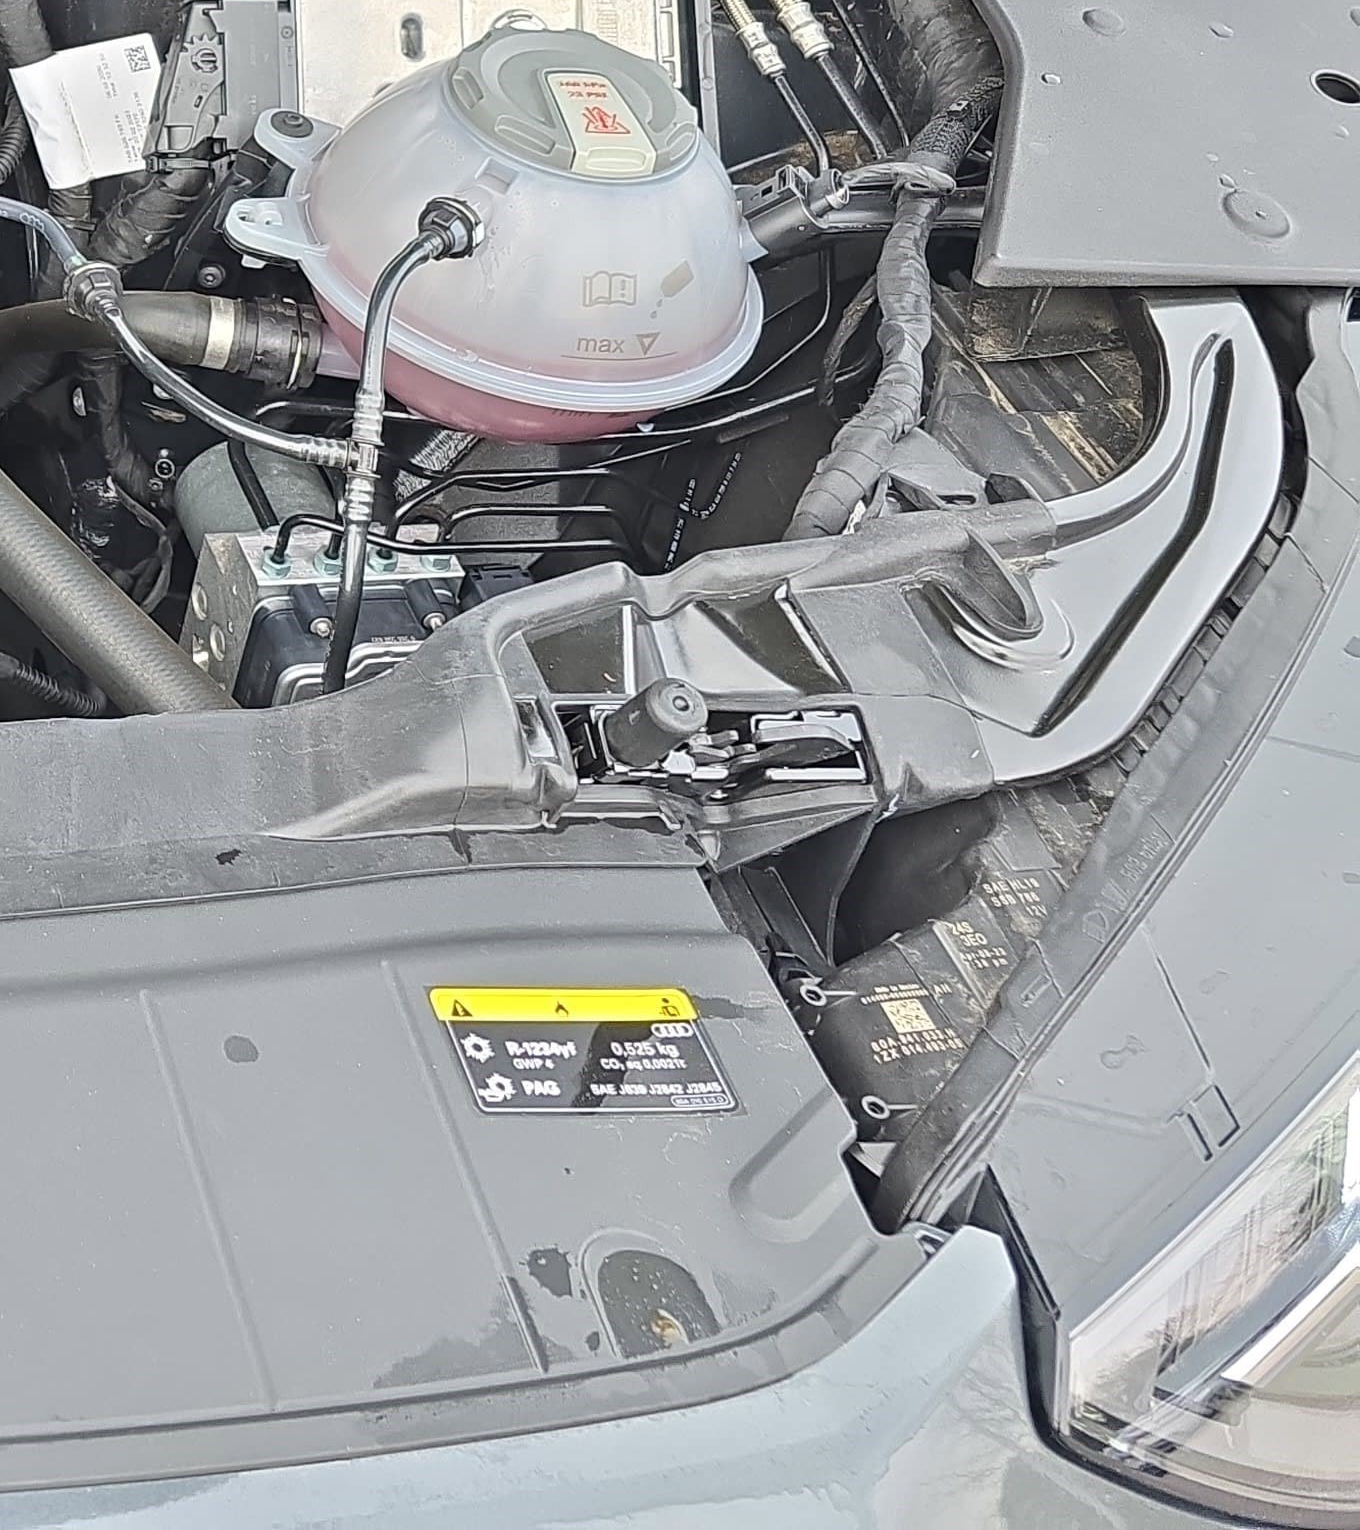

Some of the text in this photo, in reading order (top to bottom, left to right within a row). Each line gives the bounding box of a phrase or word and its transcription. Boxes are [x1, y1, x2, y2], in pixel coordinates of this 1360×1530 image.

[577, 337, 625, 353] max
[982, 881, 1009, 894] SAE
[947, 921, 974, 935] 24S
[505, 1041, 680, 1059] R-1234yf 0,525 kg
[512, 1058, 544, 1069] GWP
[521, 1080, 561, 1096] PAG
[590, 1083, 617, 1095] SAE
